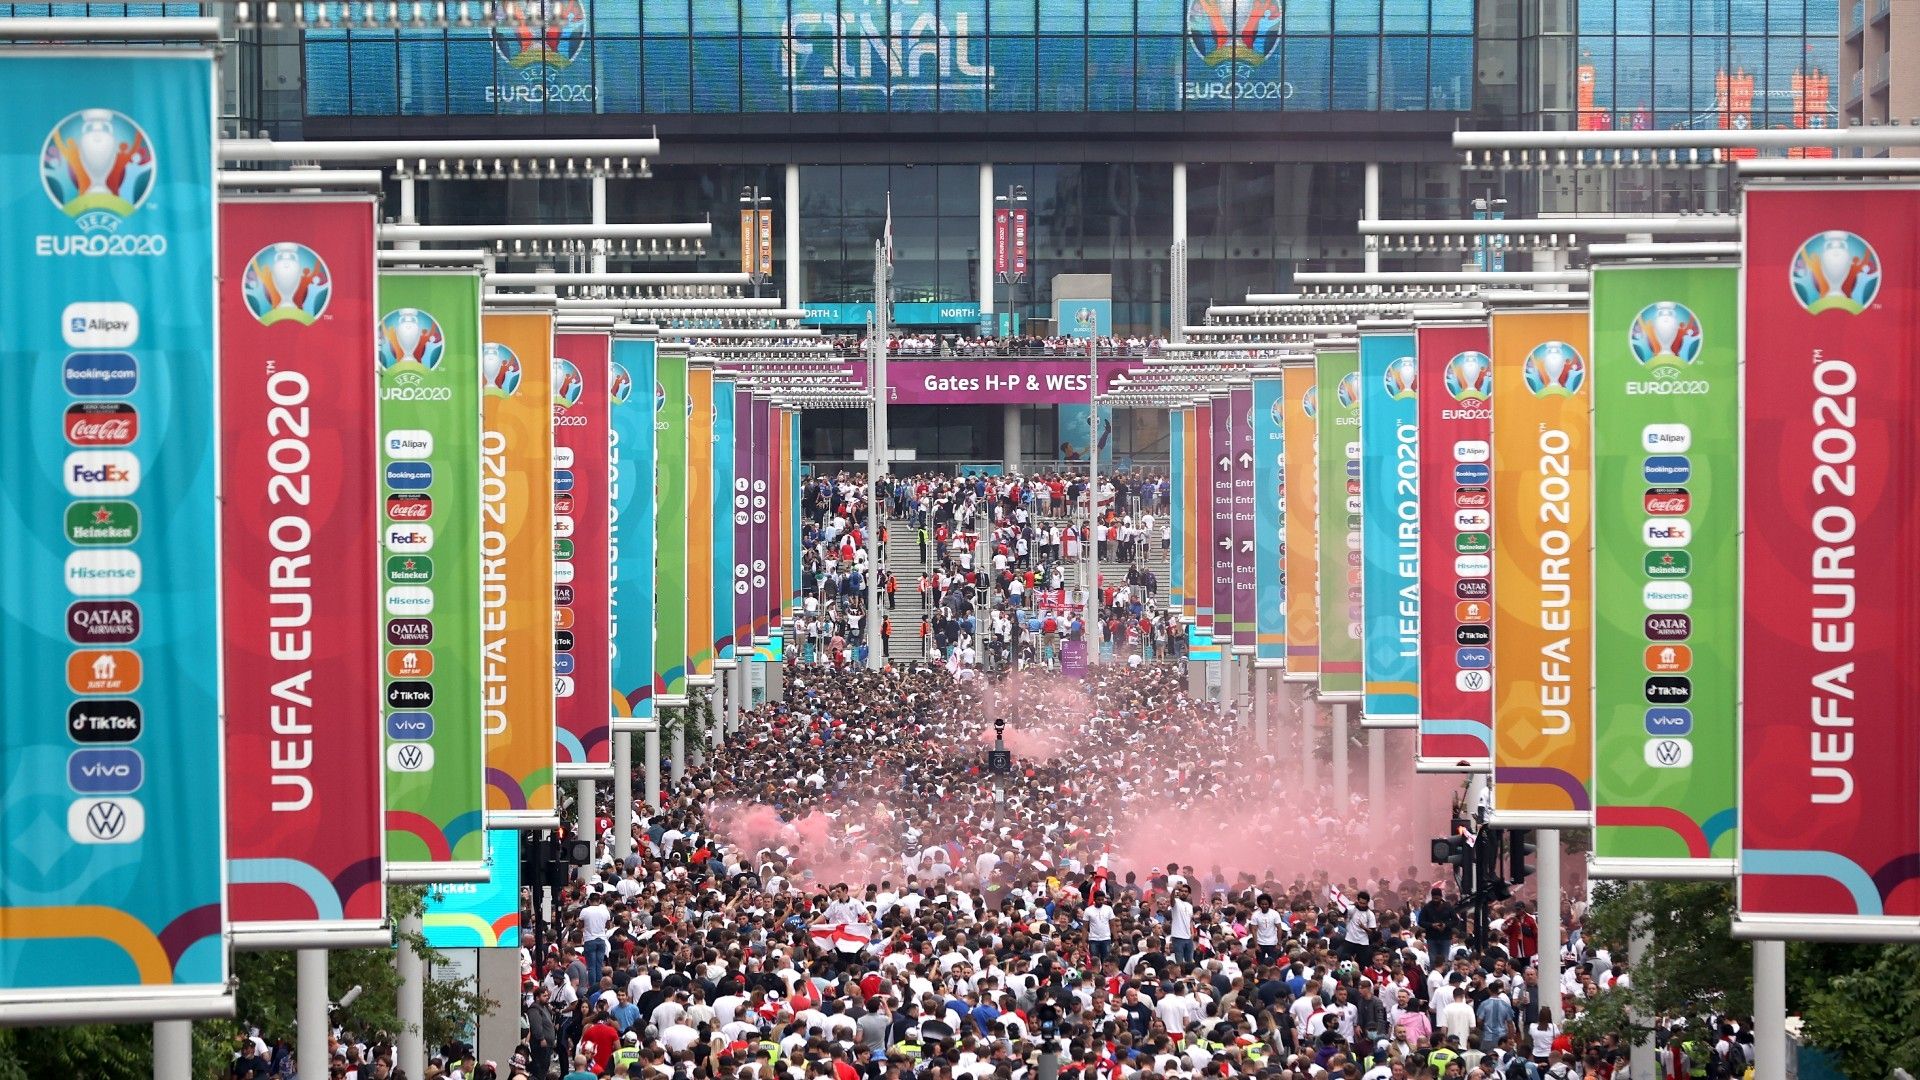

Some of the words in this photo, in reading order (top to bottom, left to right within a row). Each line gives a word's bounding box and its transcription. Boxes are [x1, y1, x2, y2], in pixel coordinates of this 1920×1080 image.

[781, 12, 995, 77] FINAL
[78, 214, 120, 231] UEFA
[36, 234, 167, 256] EURO2020
[833, 309, 839, 318] 1
[941, 308, 974, 318] NORTH
[88, 318, 128, 333] Alipay
[66, 368, 136, 382] Booking.com
[396, 373, 423, 384] UEFA
[1653, 368, 1680, 378] UEFA
[924, 375, 980, 391] Gates
[985, 375, 1020, 391] H-P
[1026, 375, 1040, 391] &
[1626, 380, 1710, 395] EURO2020
[380, 387, 451, 401] URO2020
[1442, 410, 1493, 420] EURO202
[1812, 359, 1858, 497] 2020
[267, 370, 311, 506] 2020
[401, 439, 427, 449] Alipay
[1660, 434, 1685, 443] Alipay
[1466, 448, 1485, 456] Alipay
[1397, 424, 1419, 496] 2020
[74, 464, 130, 483] FedEx
[387, 471, 431, 480] Booking.com
[1645, 465, 1689, 475] Booking.com
[481, 431, 507, 524] 2020
[1540, 429, 1570, 524] 2020
[1235, 496, 1255, 504] Entr
[1459, 515, 1485, 524] FedEx
[72, 525, 132, 539] Heineken
[391, 532, 427, 544] FedEx
[1649, 527, 1685, 539] FedEx
[1398, 501, 1420, 578] EURO
[71, 566, 135, 578] Hisense
[391, 571, 428, 579] Heineken
[1236, 565, 1256, 573] Entr
[1649, 565, 1686, 574] Heineken
[482, 533, 507, 631] EURO
[1540, 530, 1571, 631] EURO
[1811, 505, 1857, 653] EURO
[268, 515, 313, 661] EURO
[1236, 582, 1256, 590] Entr
[1459, 583, 1487, 592] QATAR
[389, 596, 430, 605] Hisense
[1647, 592, 1689, 600] Hisense
[74, 609, 134, 628] QATAR
[1399, 581, 1420, 657] UEFA
[1649, 619, 1687, 630] QATAR
[88, 625, 134, 636] AIRWAYS
[391, 624, 429, 636] QATAR
[483, 637, 507, 736] UEFA
[1541, 637, 1571, 736] UEFA
[1658, 686, 1689, 695] TikTok
[400, 692, 430, 700] TikTok
[89, 715, 136, 730] TikTok
[395, 720, 425, 730] vivo
[1653, 716, 1684, 725] vivo
[1811, 661, 1855, 804] UEFA
[271, 670, 313, 812] UEFA
[82, 761, 130, 777] vivo
